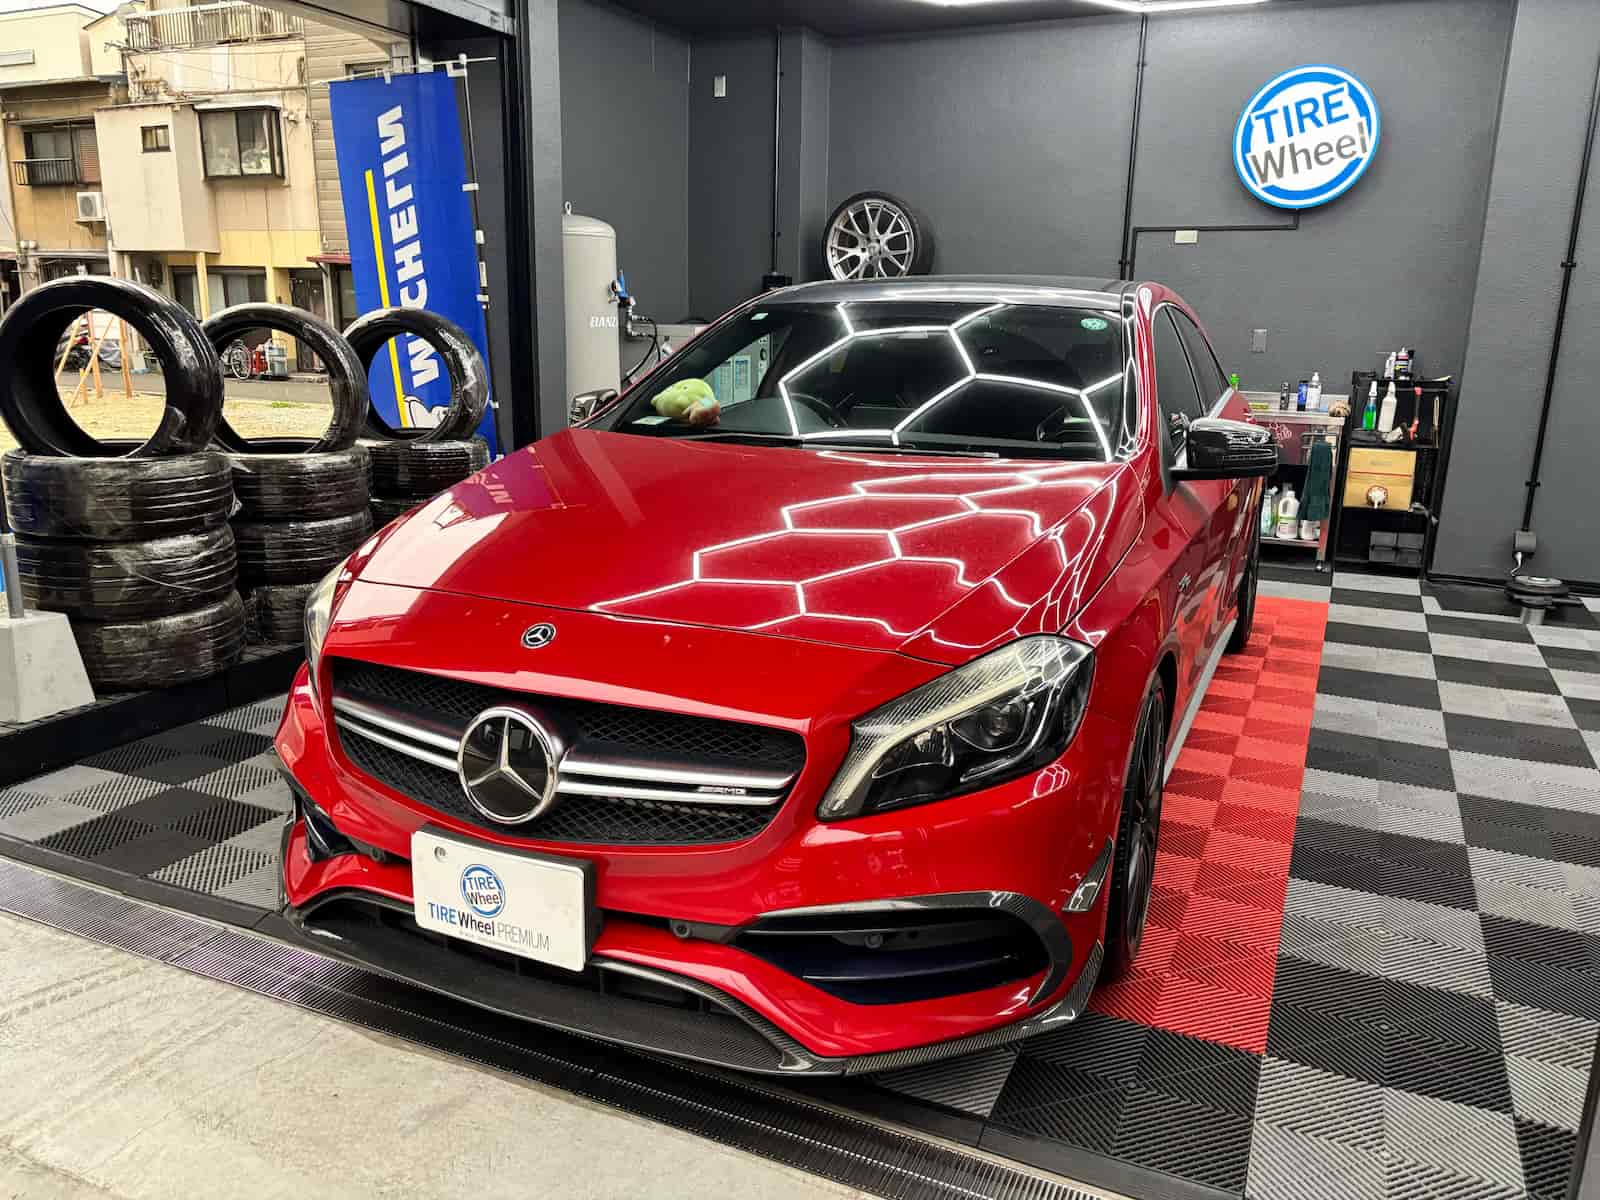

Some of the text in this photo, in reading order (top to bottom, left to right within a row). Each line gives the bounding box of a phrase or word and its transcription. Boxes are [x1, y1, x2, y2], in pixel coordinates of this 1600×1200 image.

[1254, 86, 1350, 144] TIRE
[1250, 121, 1368, 184] Wheel
[466, 891, 503, 906] Wheel
[467, 876, 496, 891] TIRE
[427, 902, 457, 925] TIRE
[457, 911, 495, 937] Wheel
[497, 922, 550, 952] PREMIUM
